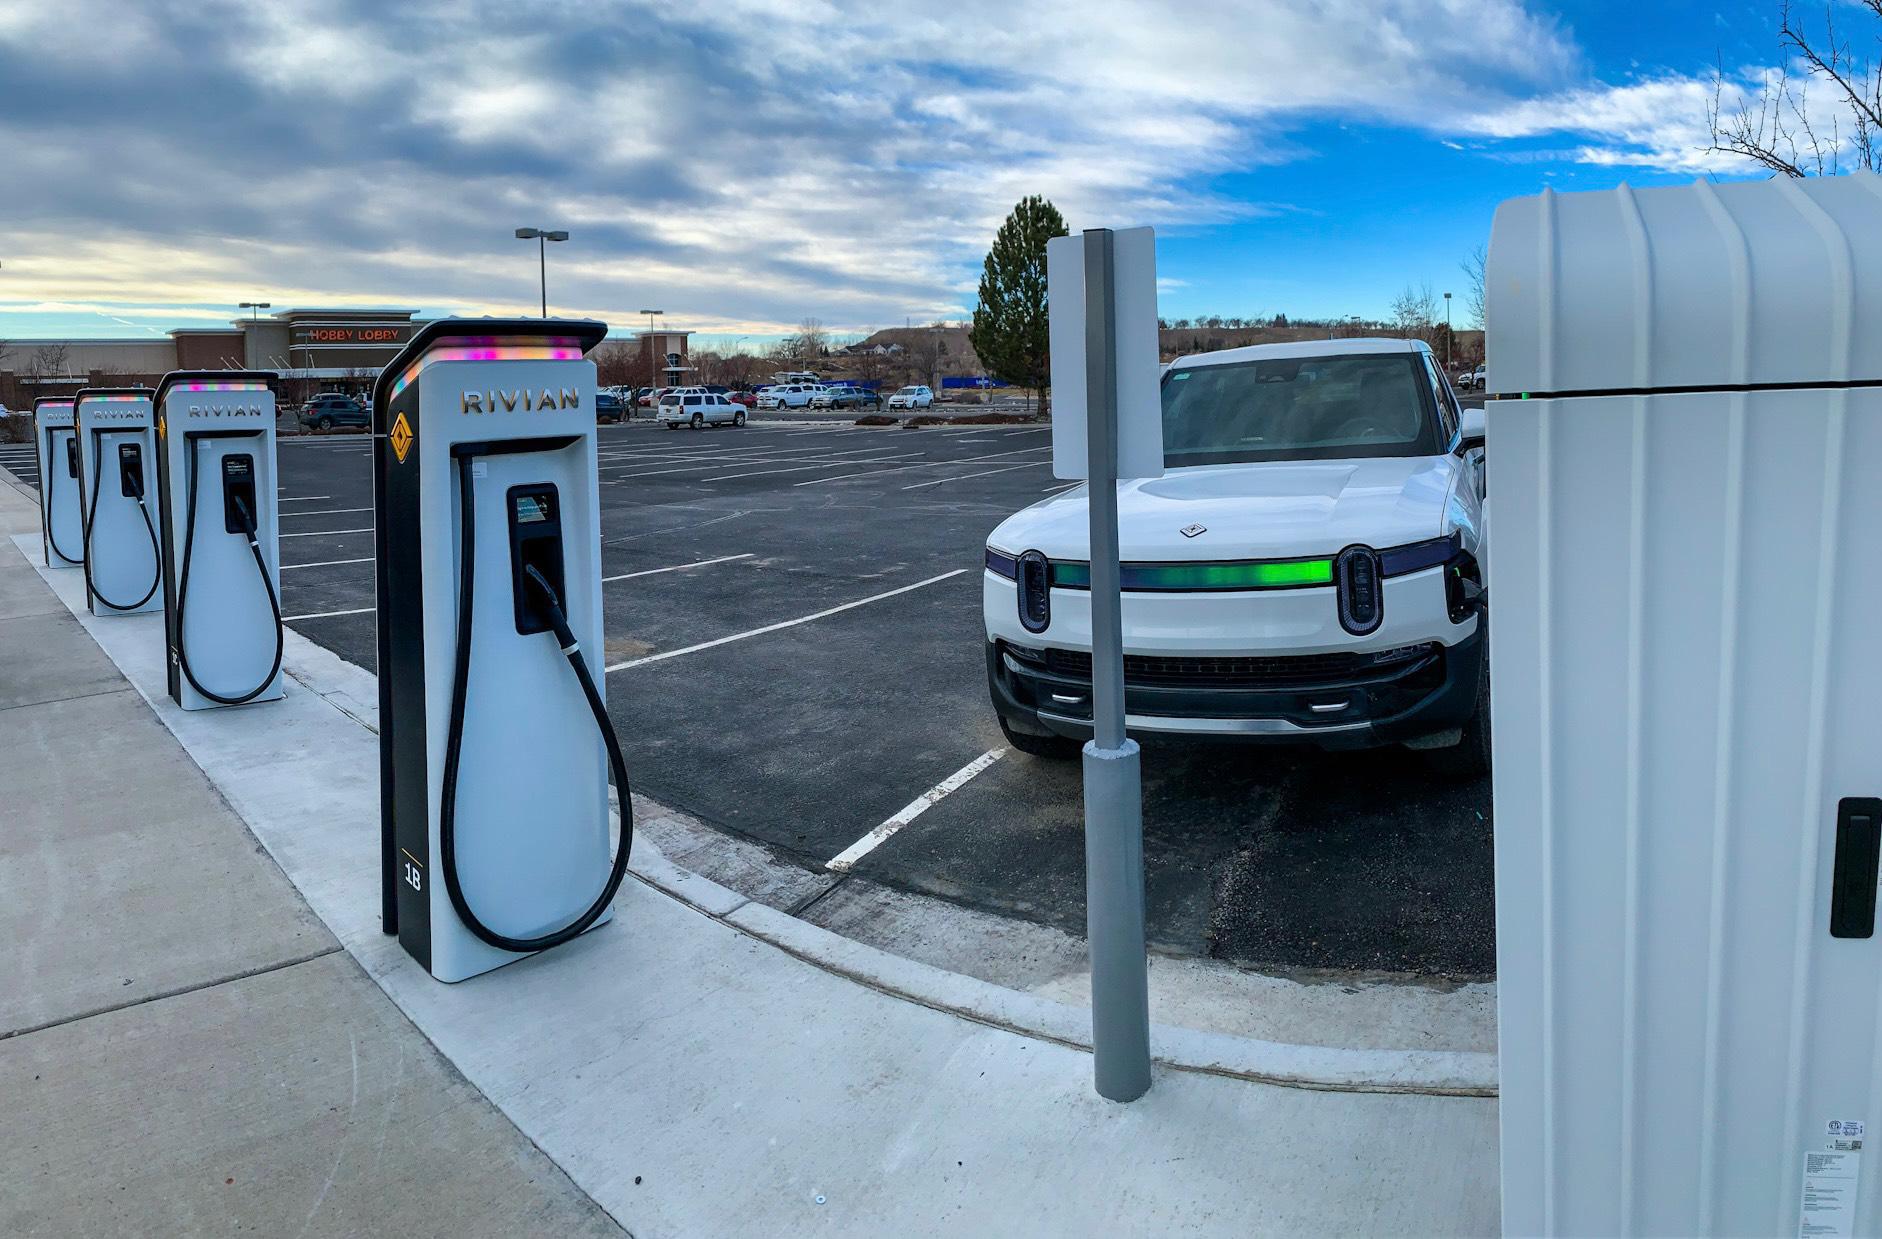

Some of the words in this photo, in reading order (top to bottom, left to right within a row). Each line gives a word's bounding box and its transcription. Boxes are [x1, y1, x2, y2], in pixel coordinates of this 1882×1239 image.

[309, 330, 352, 340] HOBBY
[358, 330, 398, 340] LOBBY
[462, 387, 579, 414] RIVIAN
[94, 410, 144, 419] RIVIAN
[189, 405, 261, 418] RIVIAN
[405, 862, 421, 891] 1B
